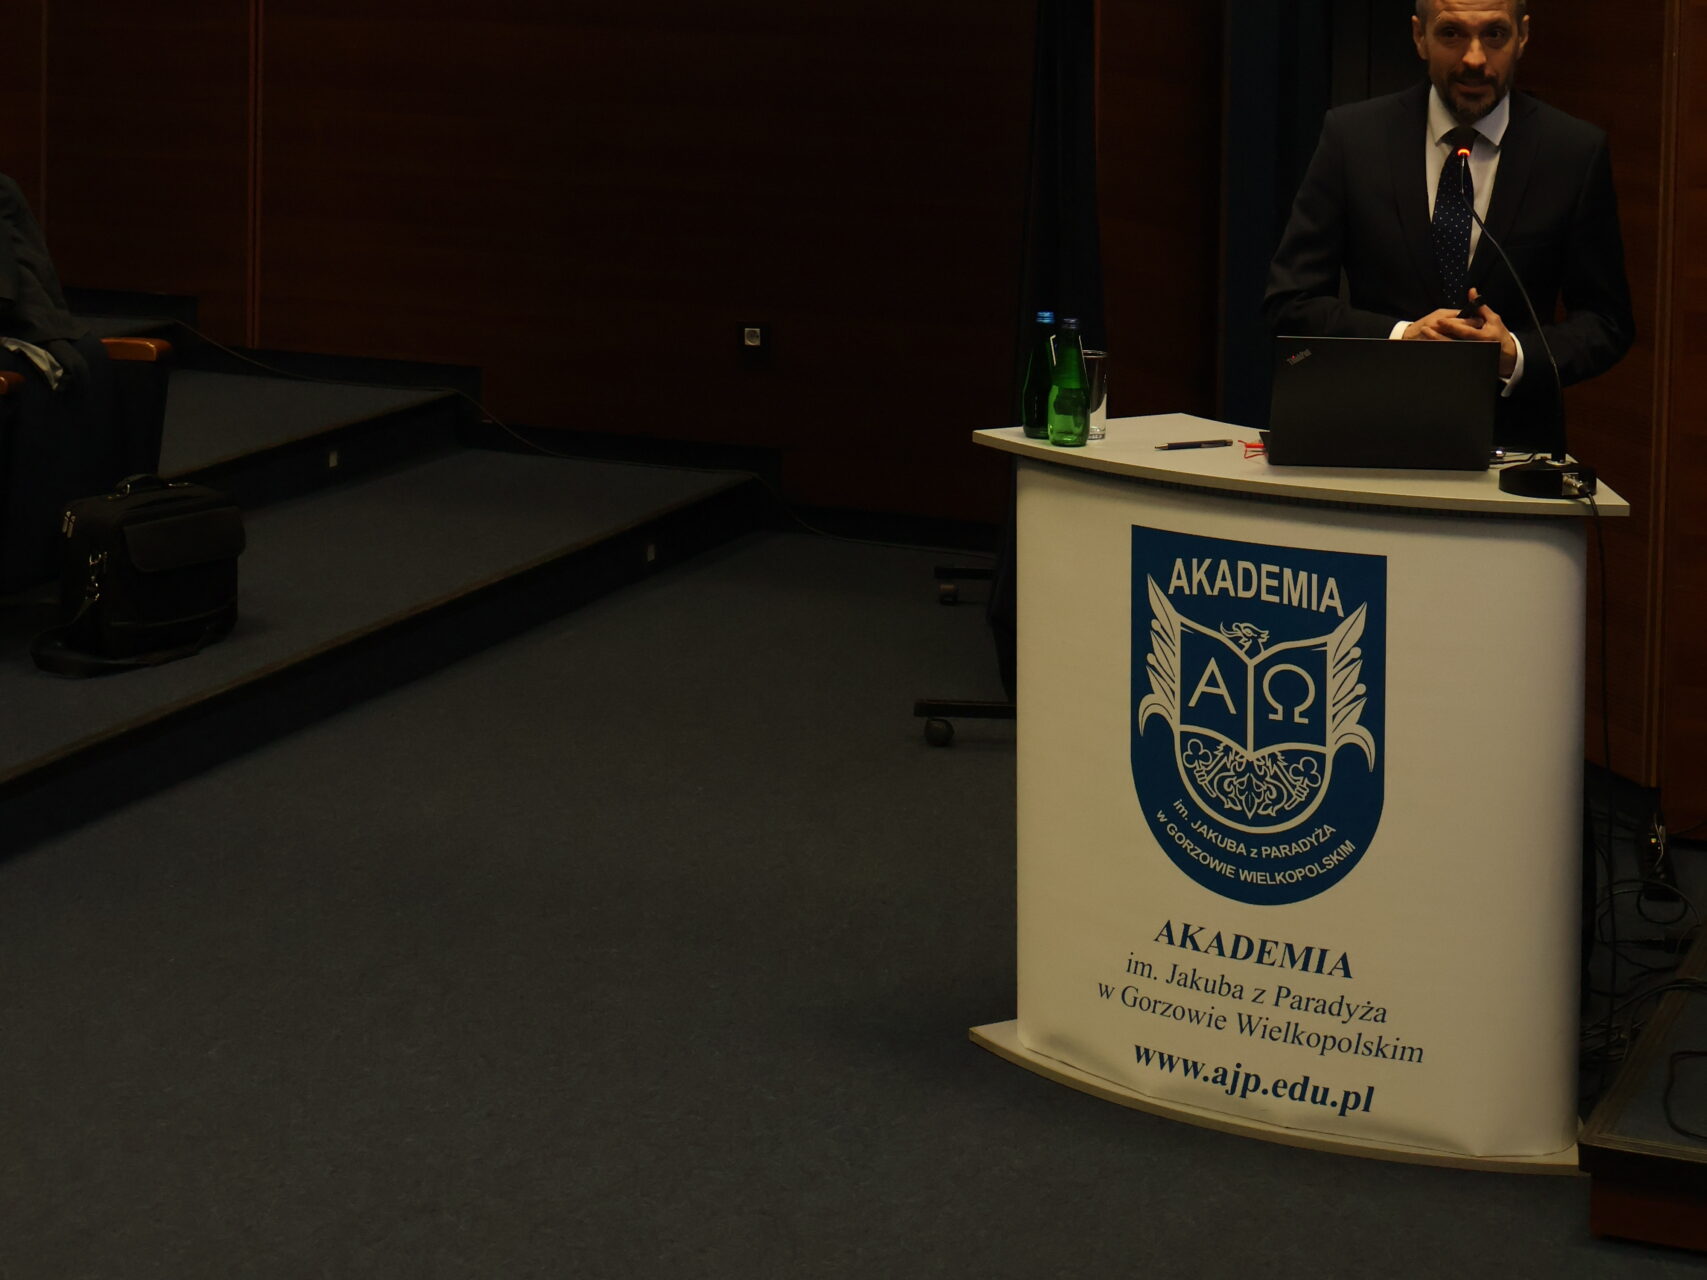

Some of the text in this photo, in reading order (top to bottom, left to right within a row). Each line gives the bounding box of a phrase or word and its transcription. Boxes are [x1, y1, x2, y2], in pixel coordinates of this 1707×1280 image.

[1168, 558, 1344, 617] AKADEMIA
[1156, 810, 1356, 885] w GORZOWIE WIELKOPOLSKIM
[1173, 799, 1336, 858] im. JAKUBA z PARADYŻA
[1154, 920, 1353, 978] AKADEMIA
[1098, 983, 1424, 1063] w Gorzowie Wielkopolskim
[1126, 952, 1387, 1024] im. Jakuba z Paradyża
[1134, 1044, 1375, 1117] www.ajp.edu.pl
